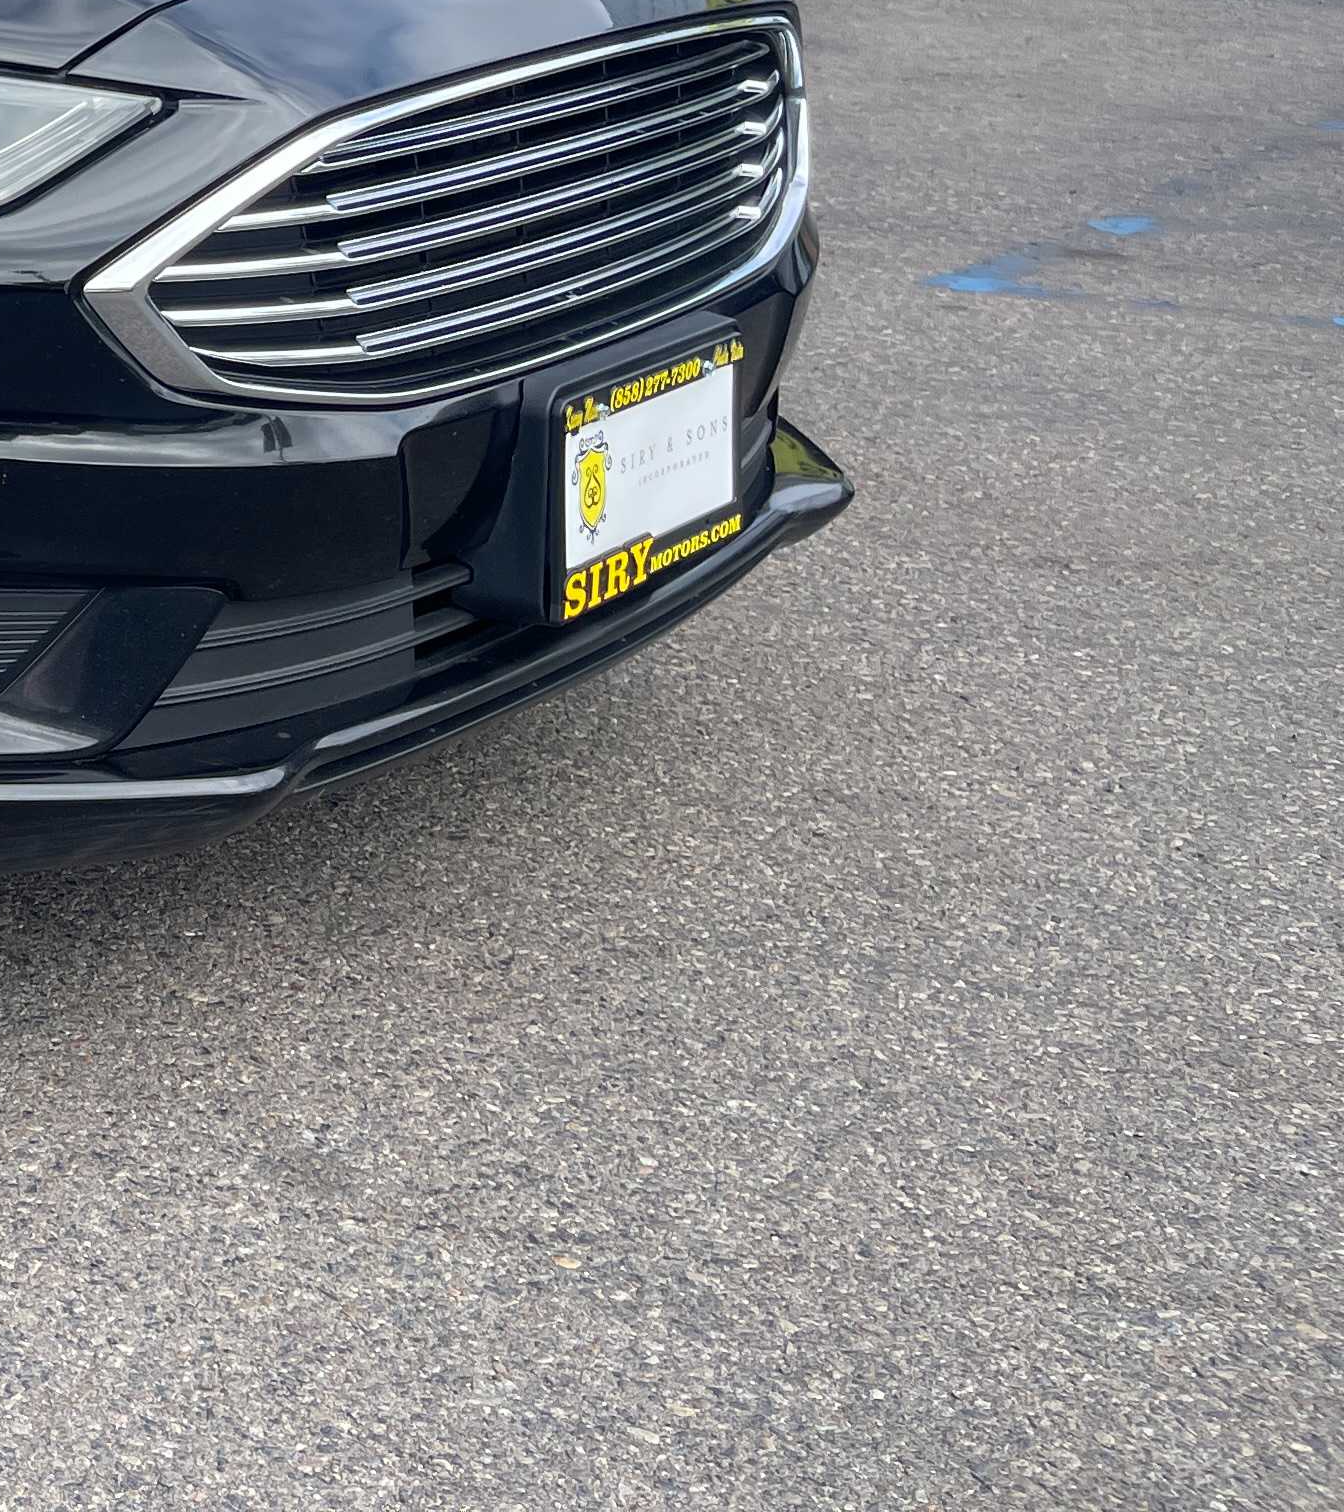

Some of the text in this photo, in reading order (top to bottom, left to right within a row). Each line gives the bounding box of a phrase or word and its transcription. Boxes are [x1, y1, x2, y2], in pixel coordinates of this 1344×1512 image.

[609, 356, 702, 413] (858) 277-7300
[620, 442, 657, 475] SIRY
[685, 415, 729, 446] SONS
[564, 514, 742, 620] SIRY MOTORS.COM
